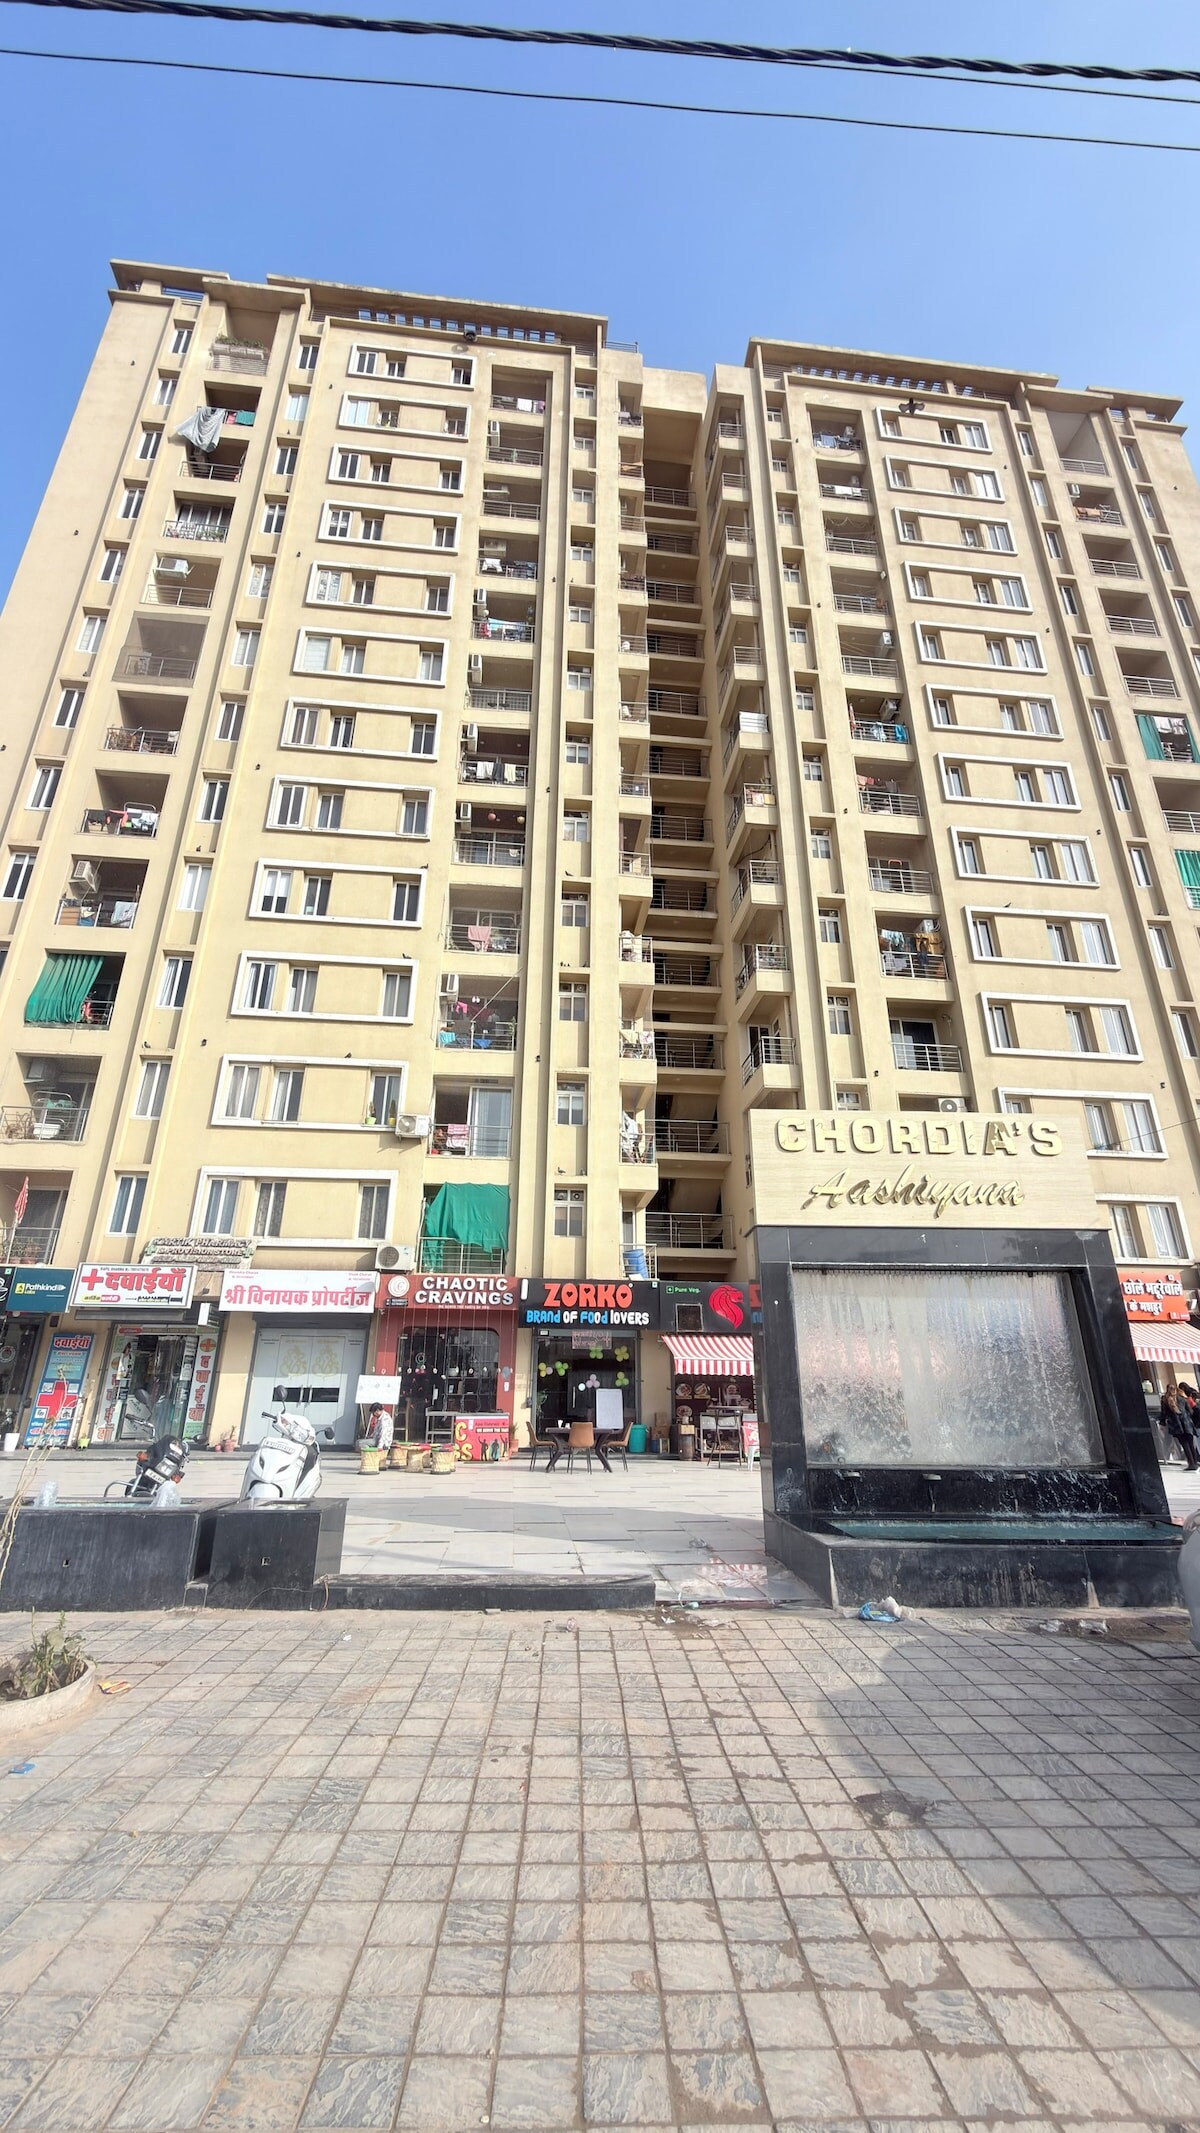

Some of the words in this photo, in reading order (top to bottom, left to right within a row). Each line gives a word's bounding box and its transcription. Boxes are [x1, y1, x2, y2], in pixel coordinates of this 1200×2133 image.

[776, 1117, 1063, 1156] CHORDIA'S
[800, 1163, 1025, 1219] Aashiyana
[194, 1238, 252, 1248] PHARMACY
[25, 1283, 57, 1291] Pathkind
[422, 1277, 508, 1291] CHAOTIC
[225, 1285, 246, 1304] श्री
[247, 1285, 309, 1305] विनायक
[415, 1290, 514, 1306] CRAVINGS
[544, 1283, 633, 1308] ZORKO
[562, 1310, 578, 1324] OF
